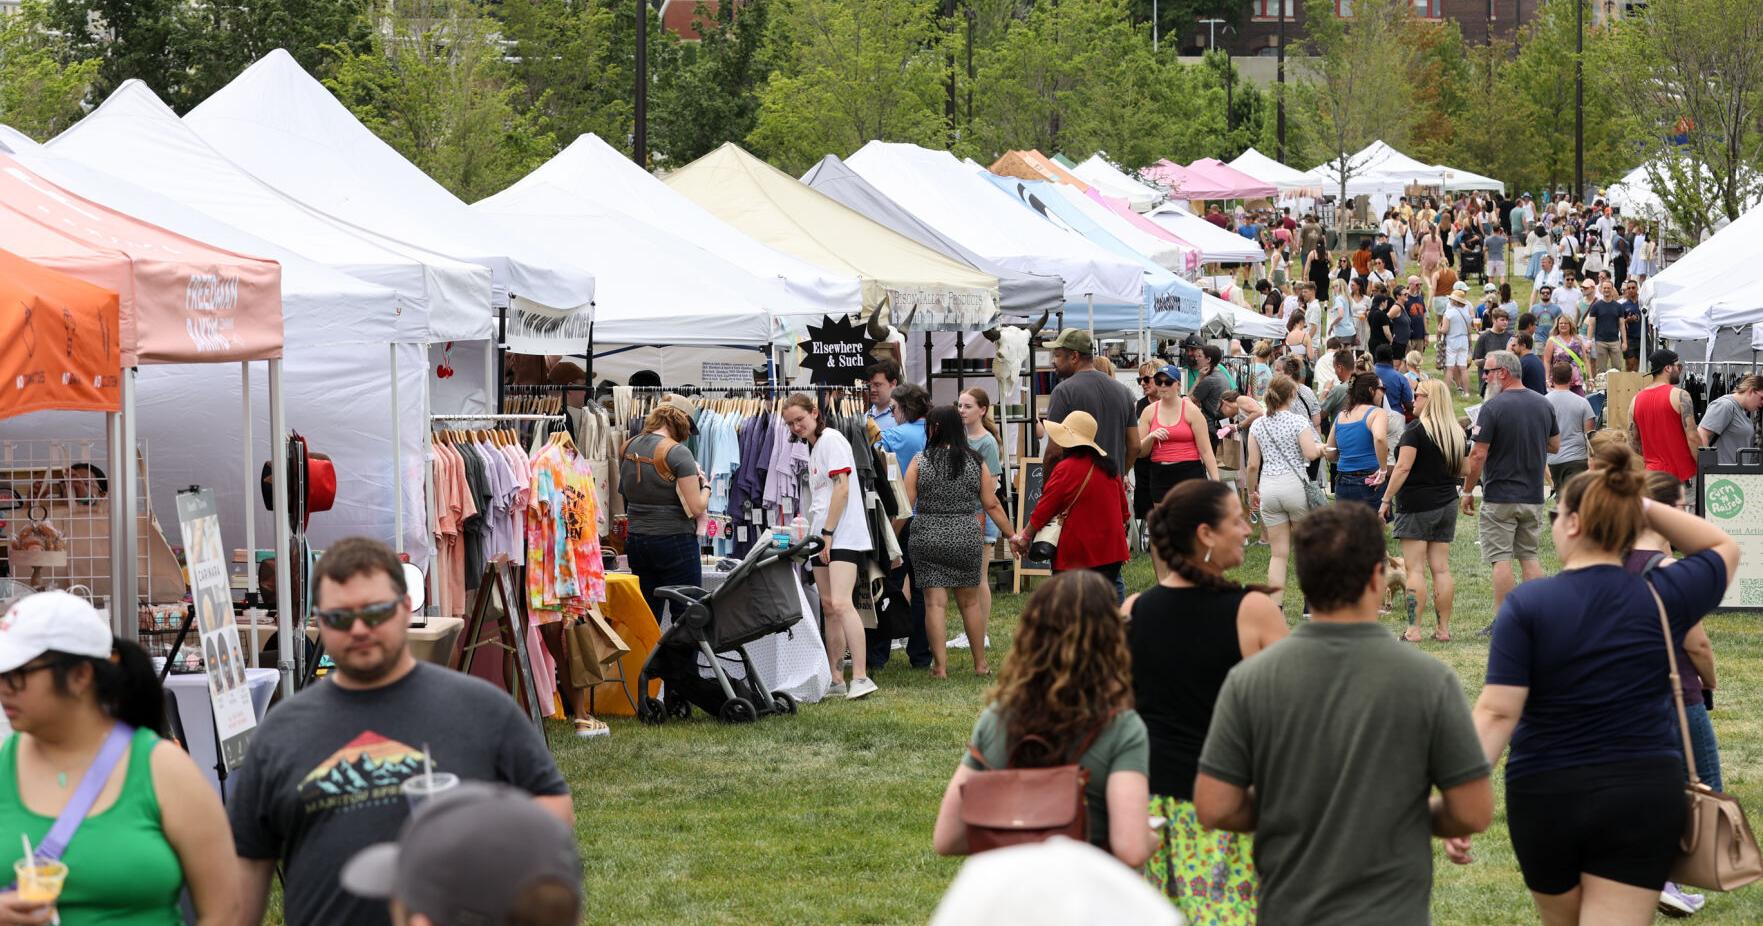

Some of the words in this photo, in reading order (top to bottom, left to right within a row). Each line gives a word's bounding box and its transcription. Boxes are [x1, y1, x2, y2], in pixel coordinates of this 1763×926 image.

[812, 341, 863, 354] Elsewhere
[827, 355, 835, 367] &
[839, 354, 864, 367] Such
[1711, 494, 1742, 513] Raised
